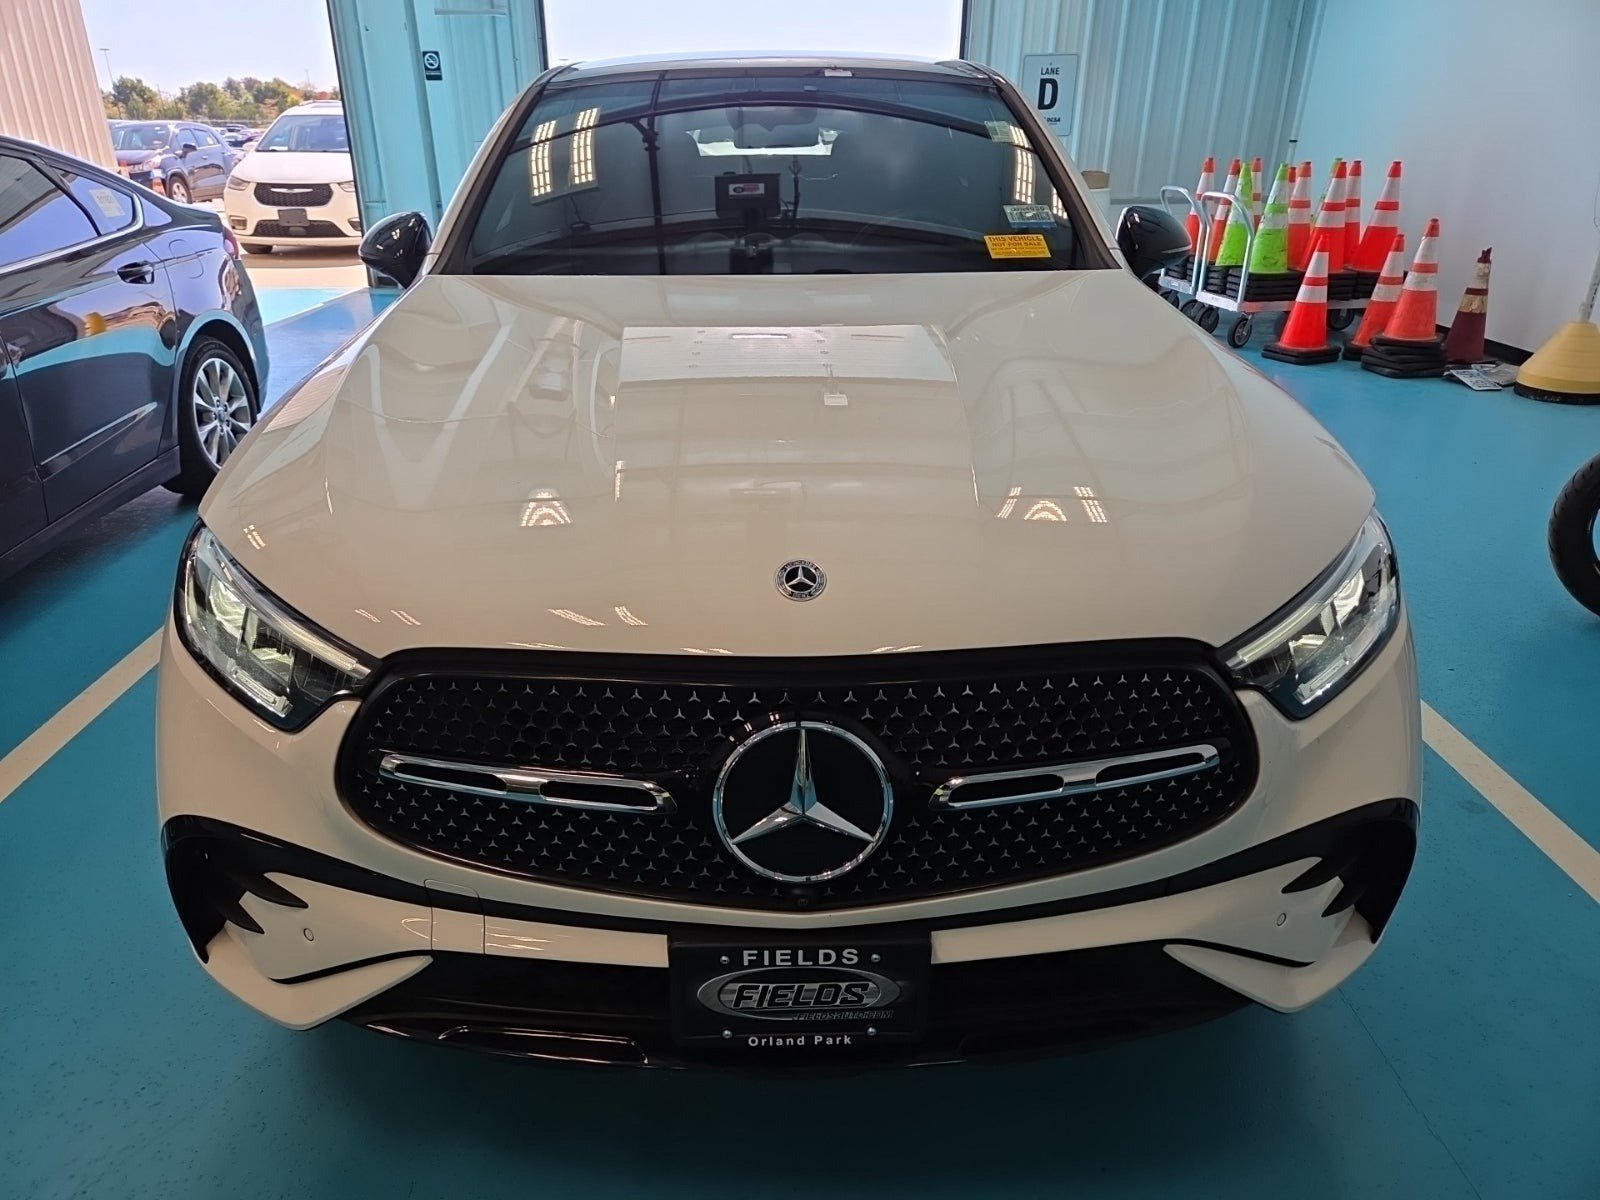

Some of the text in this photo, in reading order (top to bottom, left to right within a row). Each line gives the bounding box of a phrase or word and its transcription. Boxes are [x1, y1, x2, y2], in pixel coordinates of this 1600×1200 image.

[1040, 66, 1060, 76] LANE
[1037, 78, 1059, 110] D
[742, 948, 860, 966] FIELDS
[732, 982, 870, 1009] FIELDS
[747, 1034, 852, 1047] Orland Park
